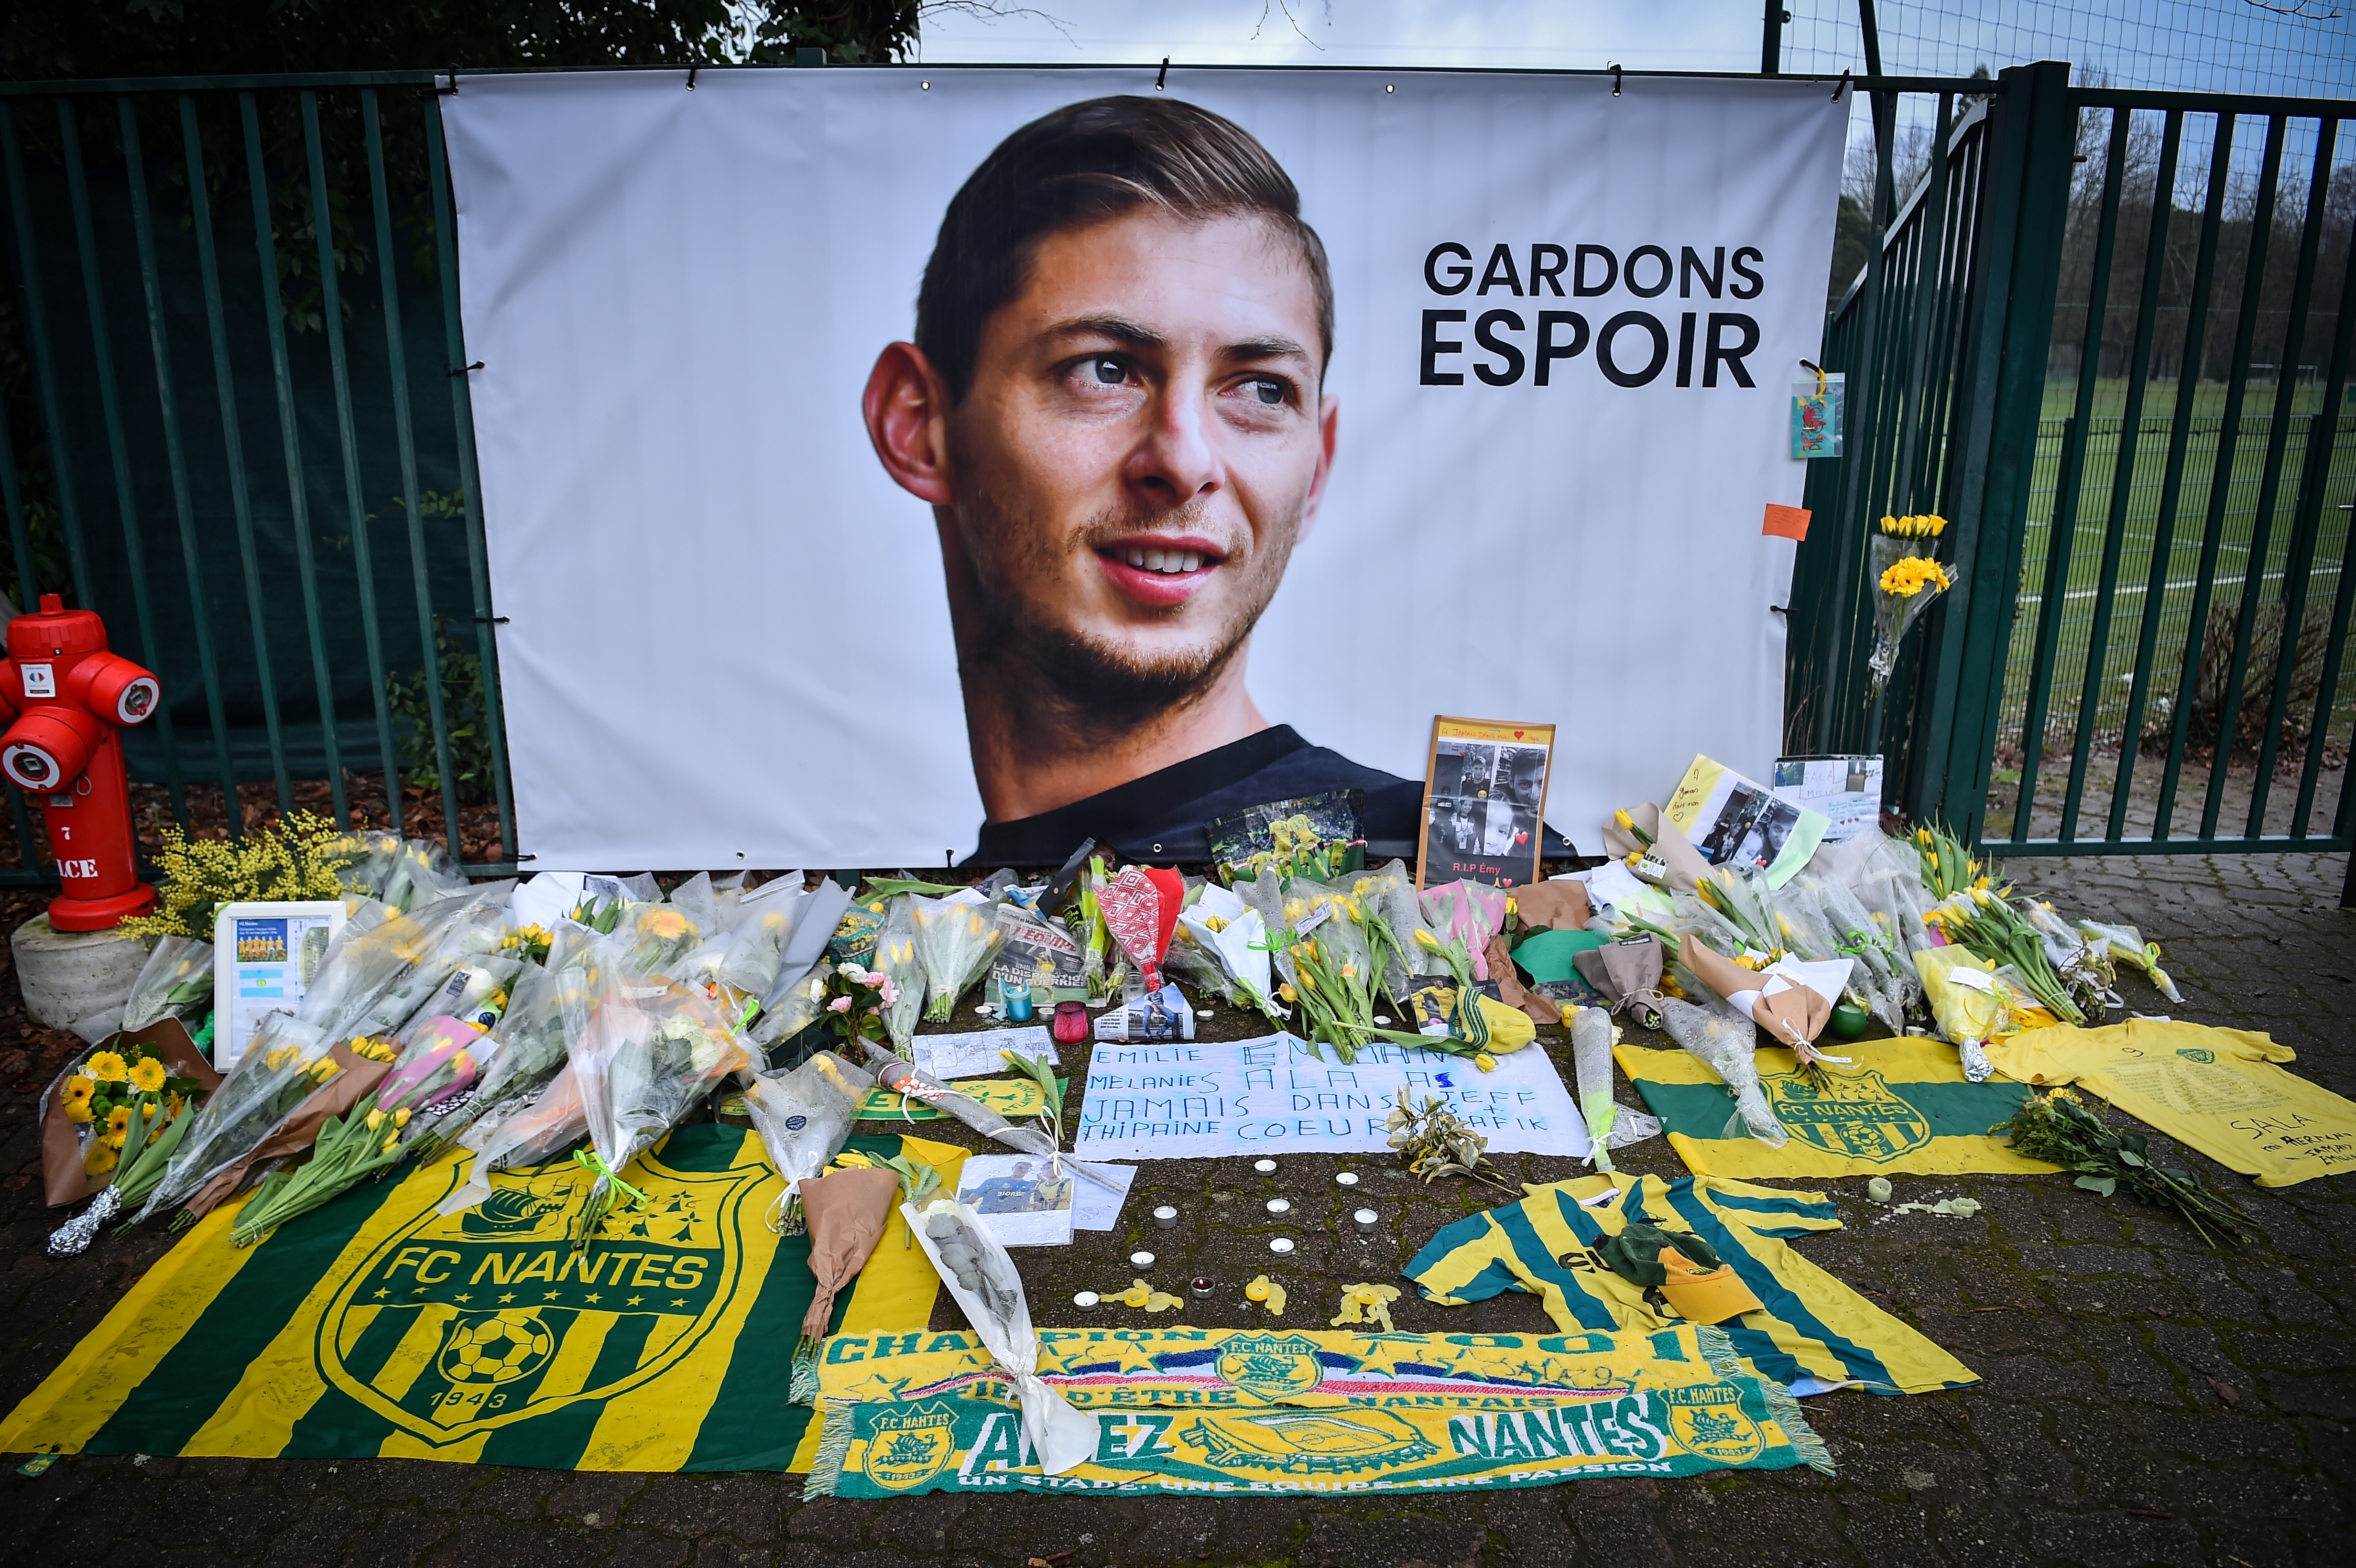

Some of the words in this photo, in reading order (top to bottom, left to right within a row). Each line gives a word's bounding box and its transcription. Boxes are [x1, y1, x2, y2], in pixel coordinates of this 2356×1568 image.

[1424, 242, 1764, 299] GARDONS
[1420, 309, 1761, 388] ESPOIR
[1452, 729, 1476, 737] JAMAIS
[1804, 770, 1833, 785] SALA
[61, 827, 70, 840] 7
[1292, 818, 1305, 830] 19
[1453, 862, 1477, 872] R.I.P
[1479, 862, 1501, 876] Émy
[992, 970, 1023, 985] D'UN
[993, 961, 1010, 972] LA
[1097, 1048, 1203, 1064] EMILIE
[1243, 1039, 1445, 1066] EMLIAN
[1085, 1096, 1250, 1122] JAMAIS
[1293, 1093, 1392, 1111] DANS
[1439, 1090, 1537, 1105] JEFF
[1778, 1104, 1809, 1116] FC
[1812, 1104, 1909, 1116] NANTES
[1081, 1121, 1222, 1142] THIPAINE
[1457, 1115, 1548, 1131] AFIK
[2230, 1113, 2319, 1140] SALA
[382, 1247, 460, 1284] FC
[469, 1251, 709, 1290] NANTES
[826, 1330, 1209, 1365] CHAPION
[431, 1392, 507, 1408] 1943
[957, 1412, 1177, 1477] AEZ
[1448, 1394, 1668, 1461] NANTES
[958, 1476, 1008, 1485] UN
[1159, 1480, 1233, 1491] UNE
[1420, 1475, 1494, 1487] UNE
[1510, 1462, 1673, 1482] PASSION
